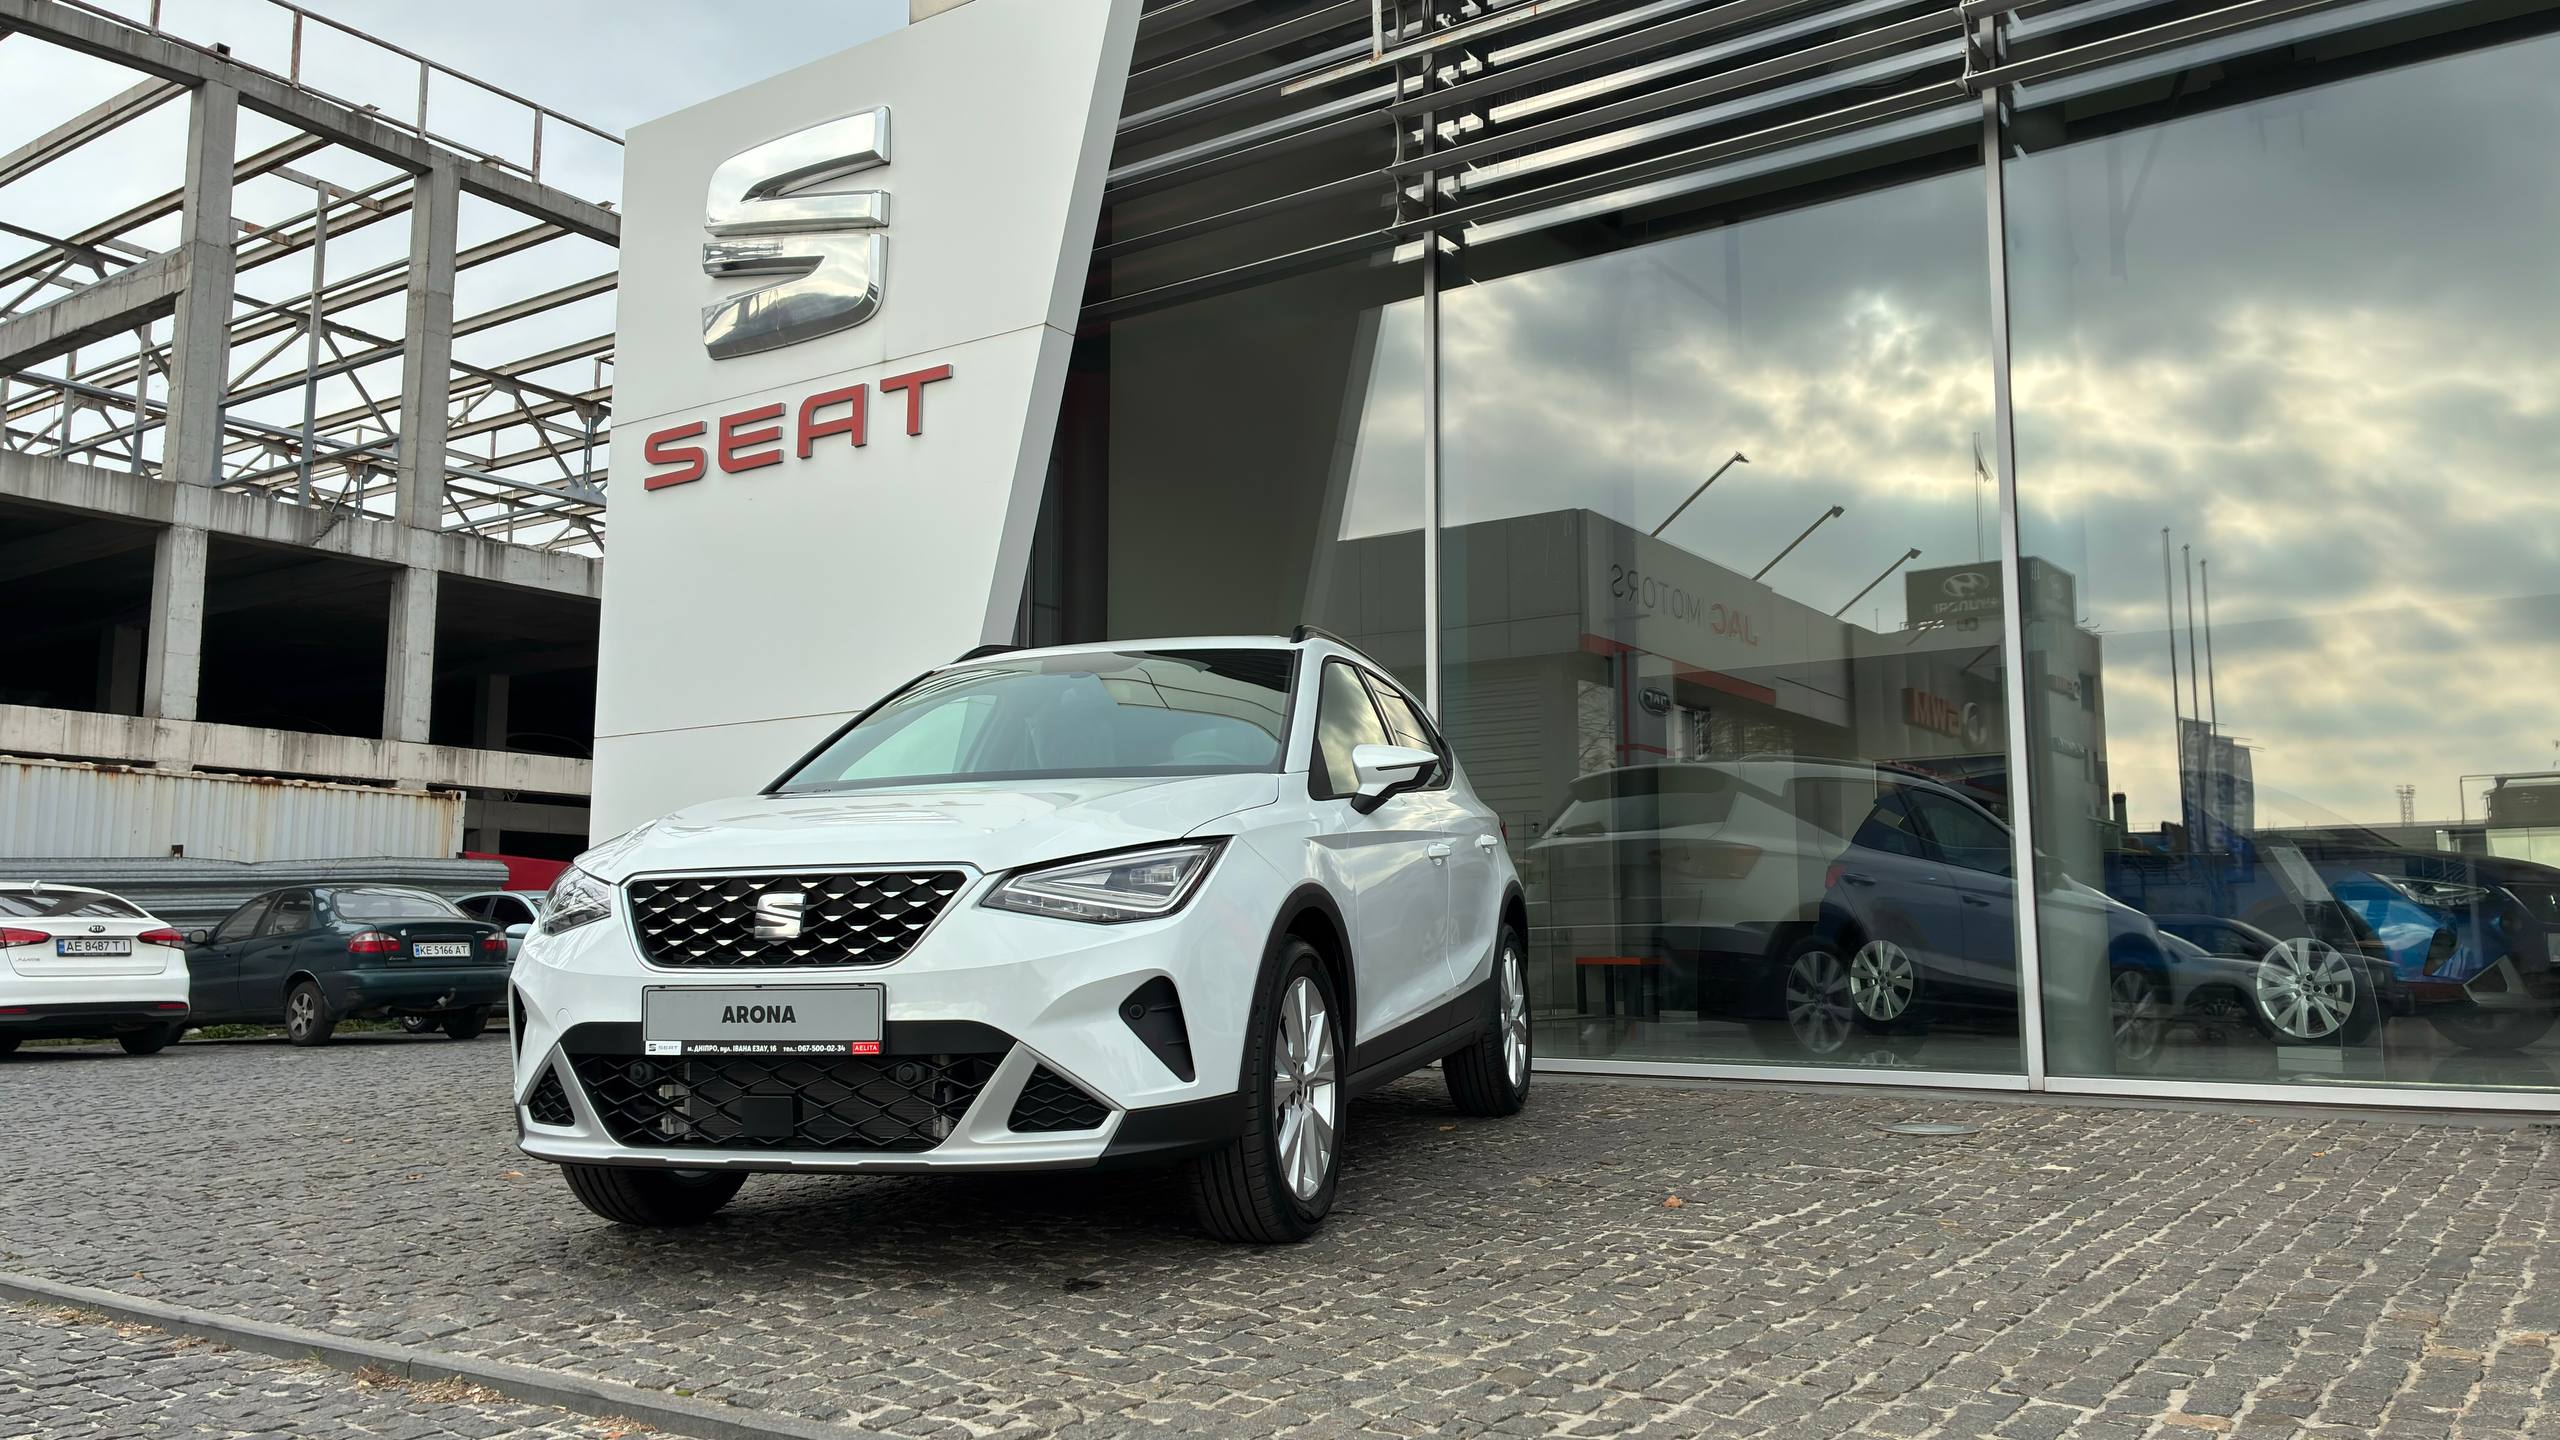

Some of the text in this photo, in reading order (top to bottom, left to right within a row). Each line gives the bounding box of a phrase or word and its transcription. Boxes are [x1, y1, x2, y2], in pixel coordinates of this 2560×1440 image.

[644, 363, 953, 491] SEAT
[66, 941, 82, 951] AE
[85, 941, 109, 951] 8487
[420, 945, 467, 955] KE 5166 AT
[721, 1005, 796, 1023] ARONA
